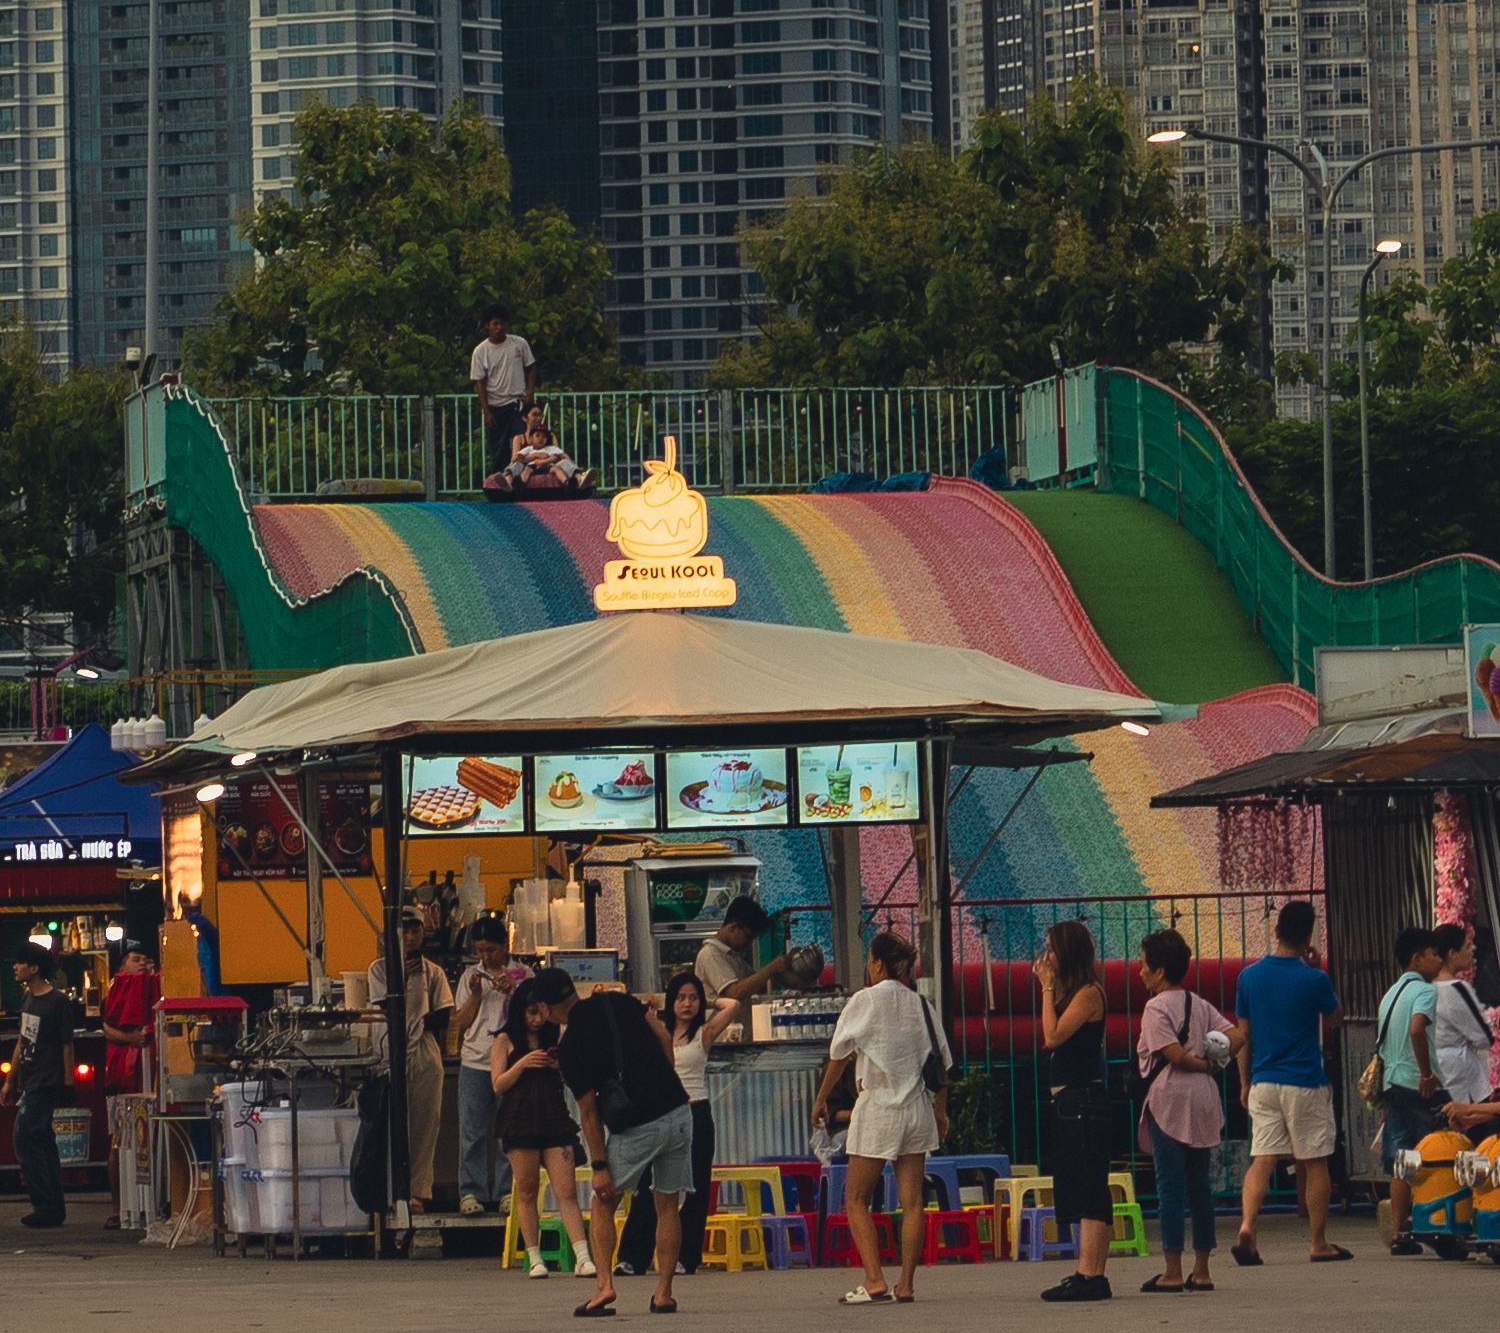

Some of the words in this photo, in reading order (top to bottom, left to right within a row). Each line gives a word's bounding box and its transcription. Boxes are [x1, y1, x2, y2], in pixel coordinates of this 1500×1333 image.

[670, 565, 716, 579] KOOL
[15, 841, 36, 861] TRÀ
[82, 841, 114, 859] NƯỚC
[117, 838, 132, 858] ÉP
